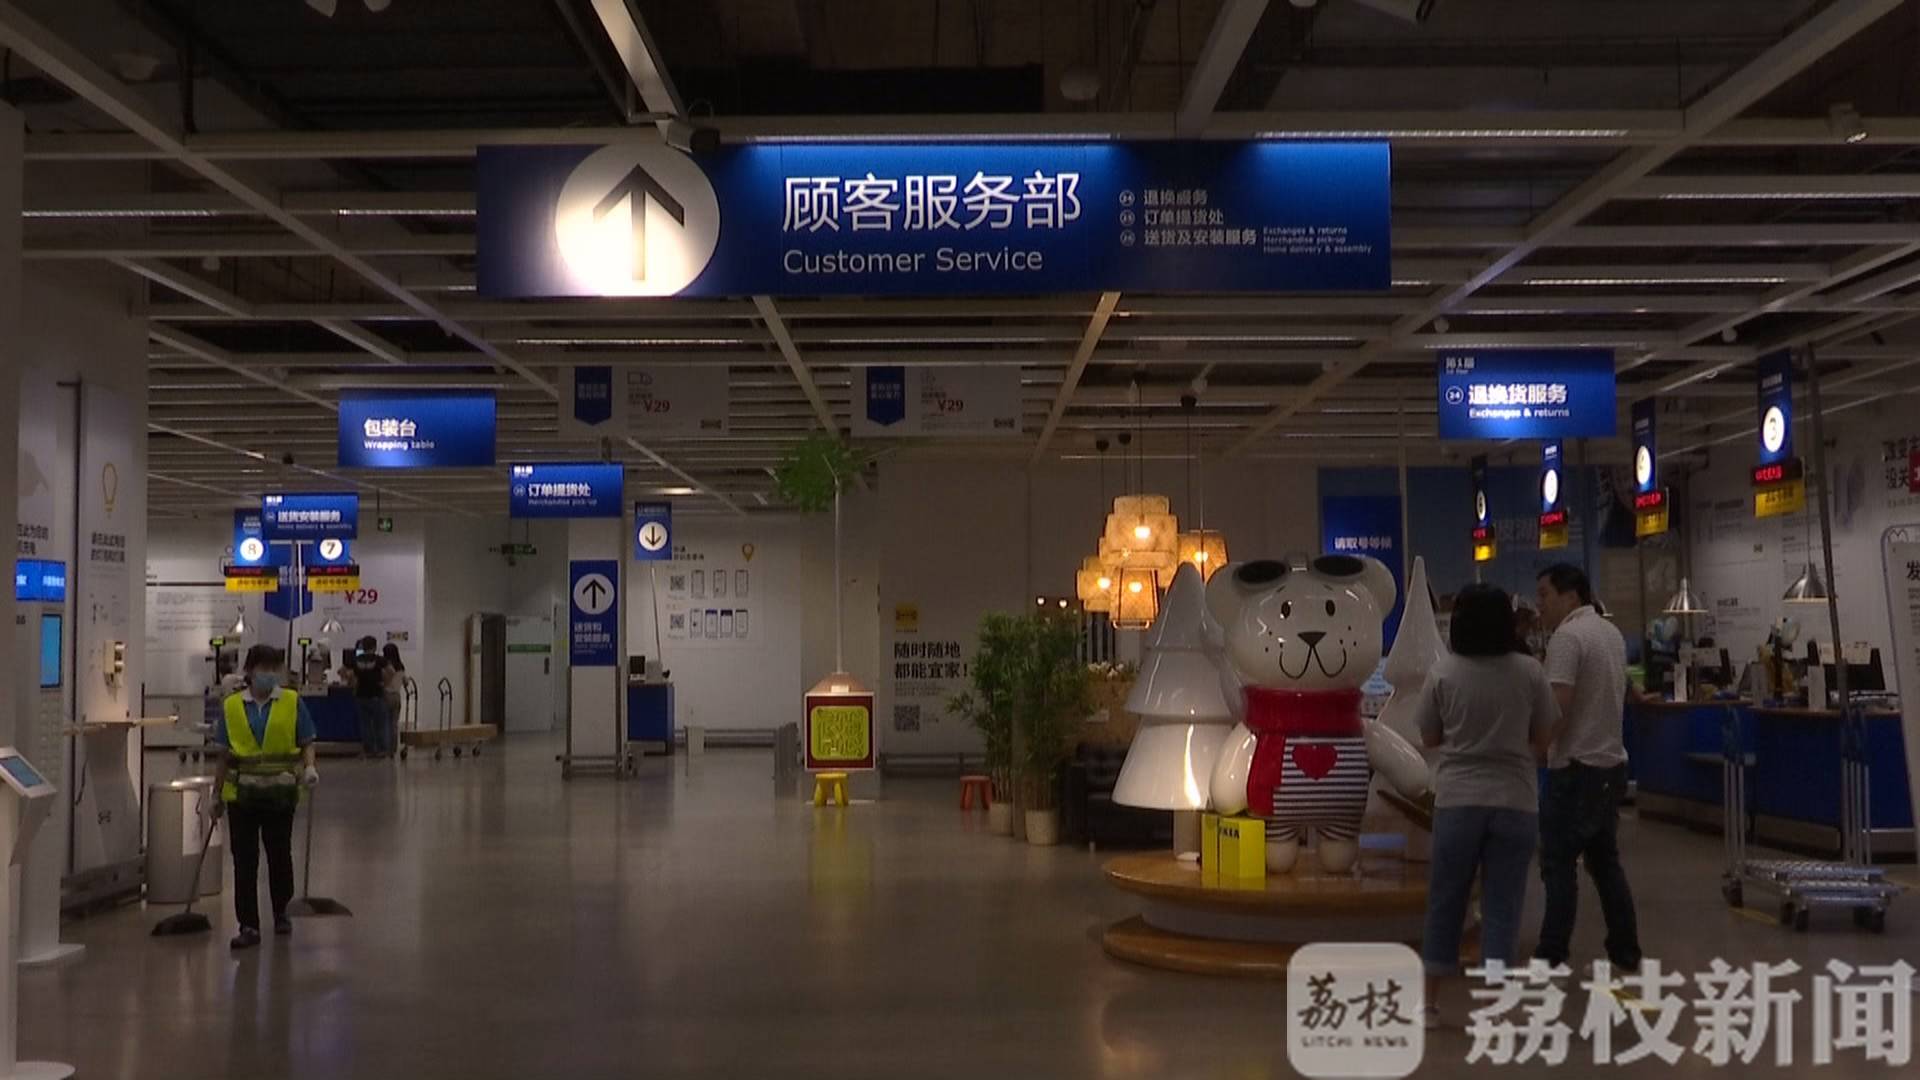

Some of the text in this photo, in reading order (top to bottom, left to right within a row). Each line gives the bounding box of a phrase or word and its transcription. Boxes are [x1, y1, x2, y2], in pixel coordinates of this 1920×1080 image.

[782, 170, 1083, 232] 顾客服务部
[1144, 209, 1224, 225] 订单提货处
[1144, 228, 1257, 246] 送货及安装服务
[1263, 226, 1306, 236] Exchanges
[1316, 227, 1348, 235] returns
[1263, 235, 1314, 244] Merchandise
[1263, 245, 1287, 254] Home
[1289, 245, 1322, 255] delivery
[1333, 245, 1372, 255] assembly
[783, 247, 1043, 273] Customer Service
[1468, 383, 1568, 405] 退换货服务
[643, 399, 671, 412] ¥29
[1468, 407, 1570, 419] Exchanges & returns
[363, 418, 417, 438] 包装台
[364, 440, 435, 451] Wrapping table
[528, 482, 592, 497] 订单提货处
[344, 588, 378, 605] ¥29
[894, 641, 961, 659] 随时随地
[894, 662, 968, 679] 都能宜家！
